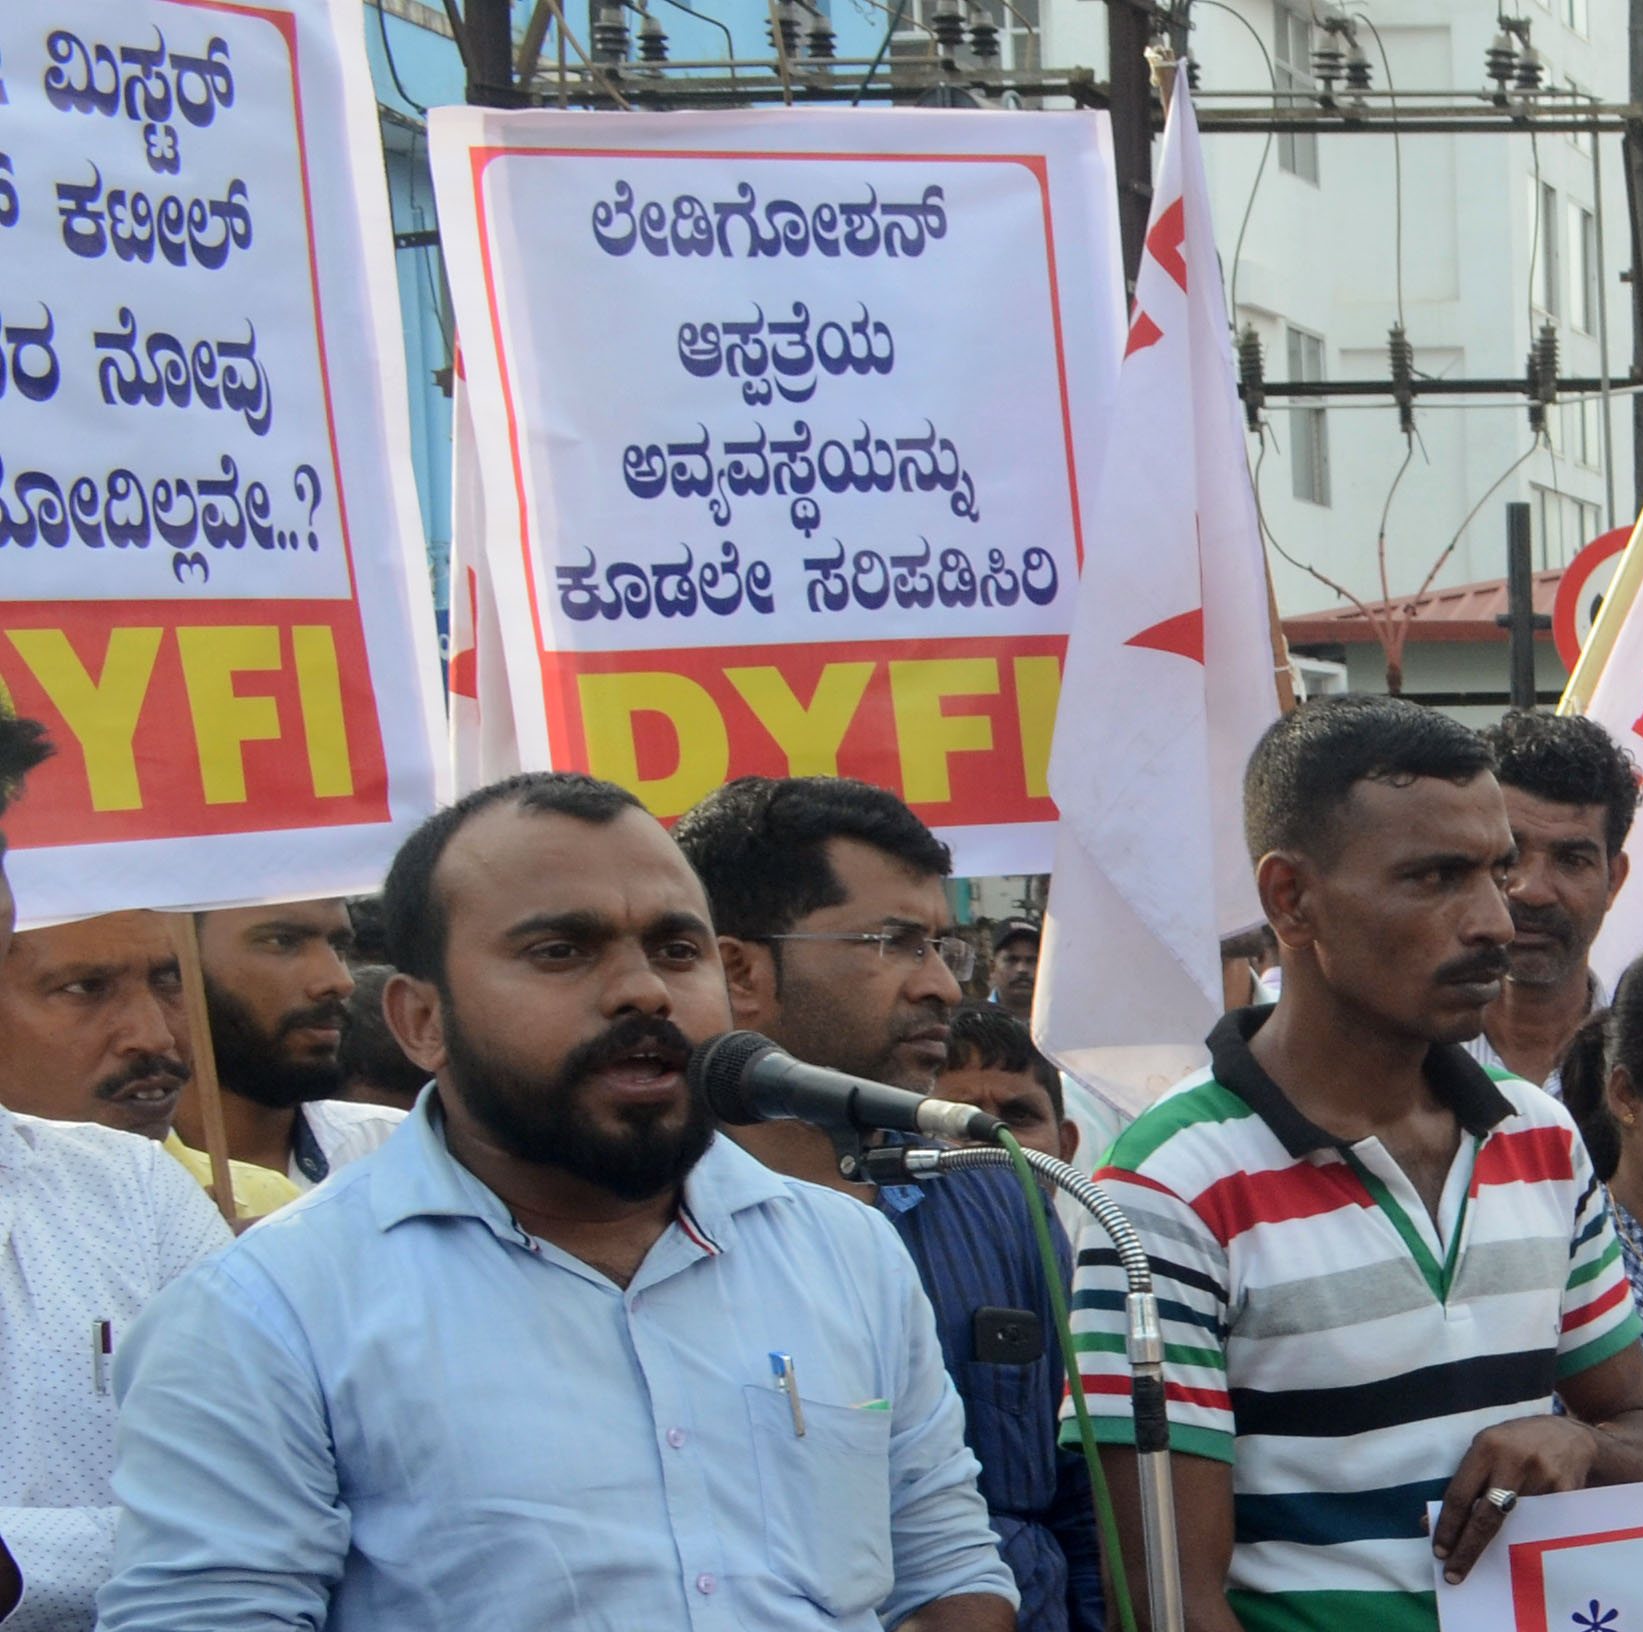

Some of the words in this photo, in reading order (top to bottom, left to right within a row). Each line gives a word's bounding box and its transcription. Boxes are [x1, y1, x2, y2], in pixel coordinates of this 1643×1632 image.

[44, 24, 235, 175] ಮಿಸ್ಟರ್
[55, 158, 253, 270] ಕಟೀಲ್
[592, 179, 948, 258] ಲೇಡಿಗೋಶನ್
[94, 306, 272, 436] ನೋವು
[677, 301, 895, 406] ಆಸ್ಪತ್ರೆಯ
[622, 418, 980, 538] ಅವ್ಯವಸ್ಥೆಯನ್ನು
[556, 541, 776, 621] ಕೂಡಲೇ
[803, 535, 1060, 613] ಸರಿಪಡಿಸಿರಿ
[0, 625, 354, 812] YFI
[577, 655, 1062, 818] DYFI
